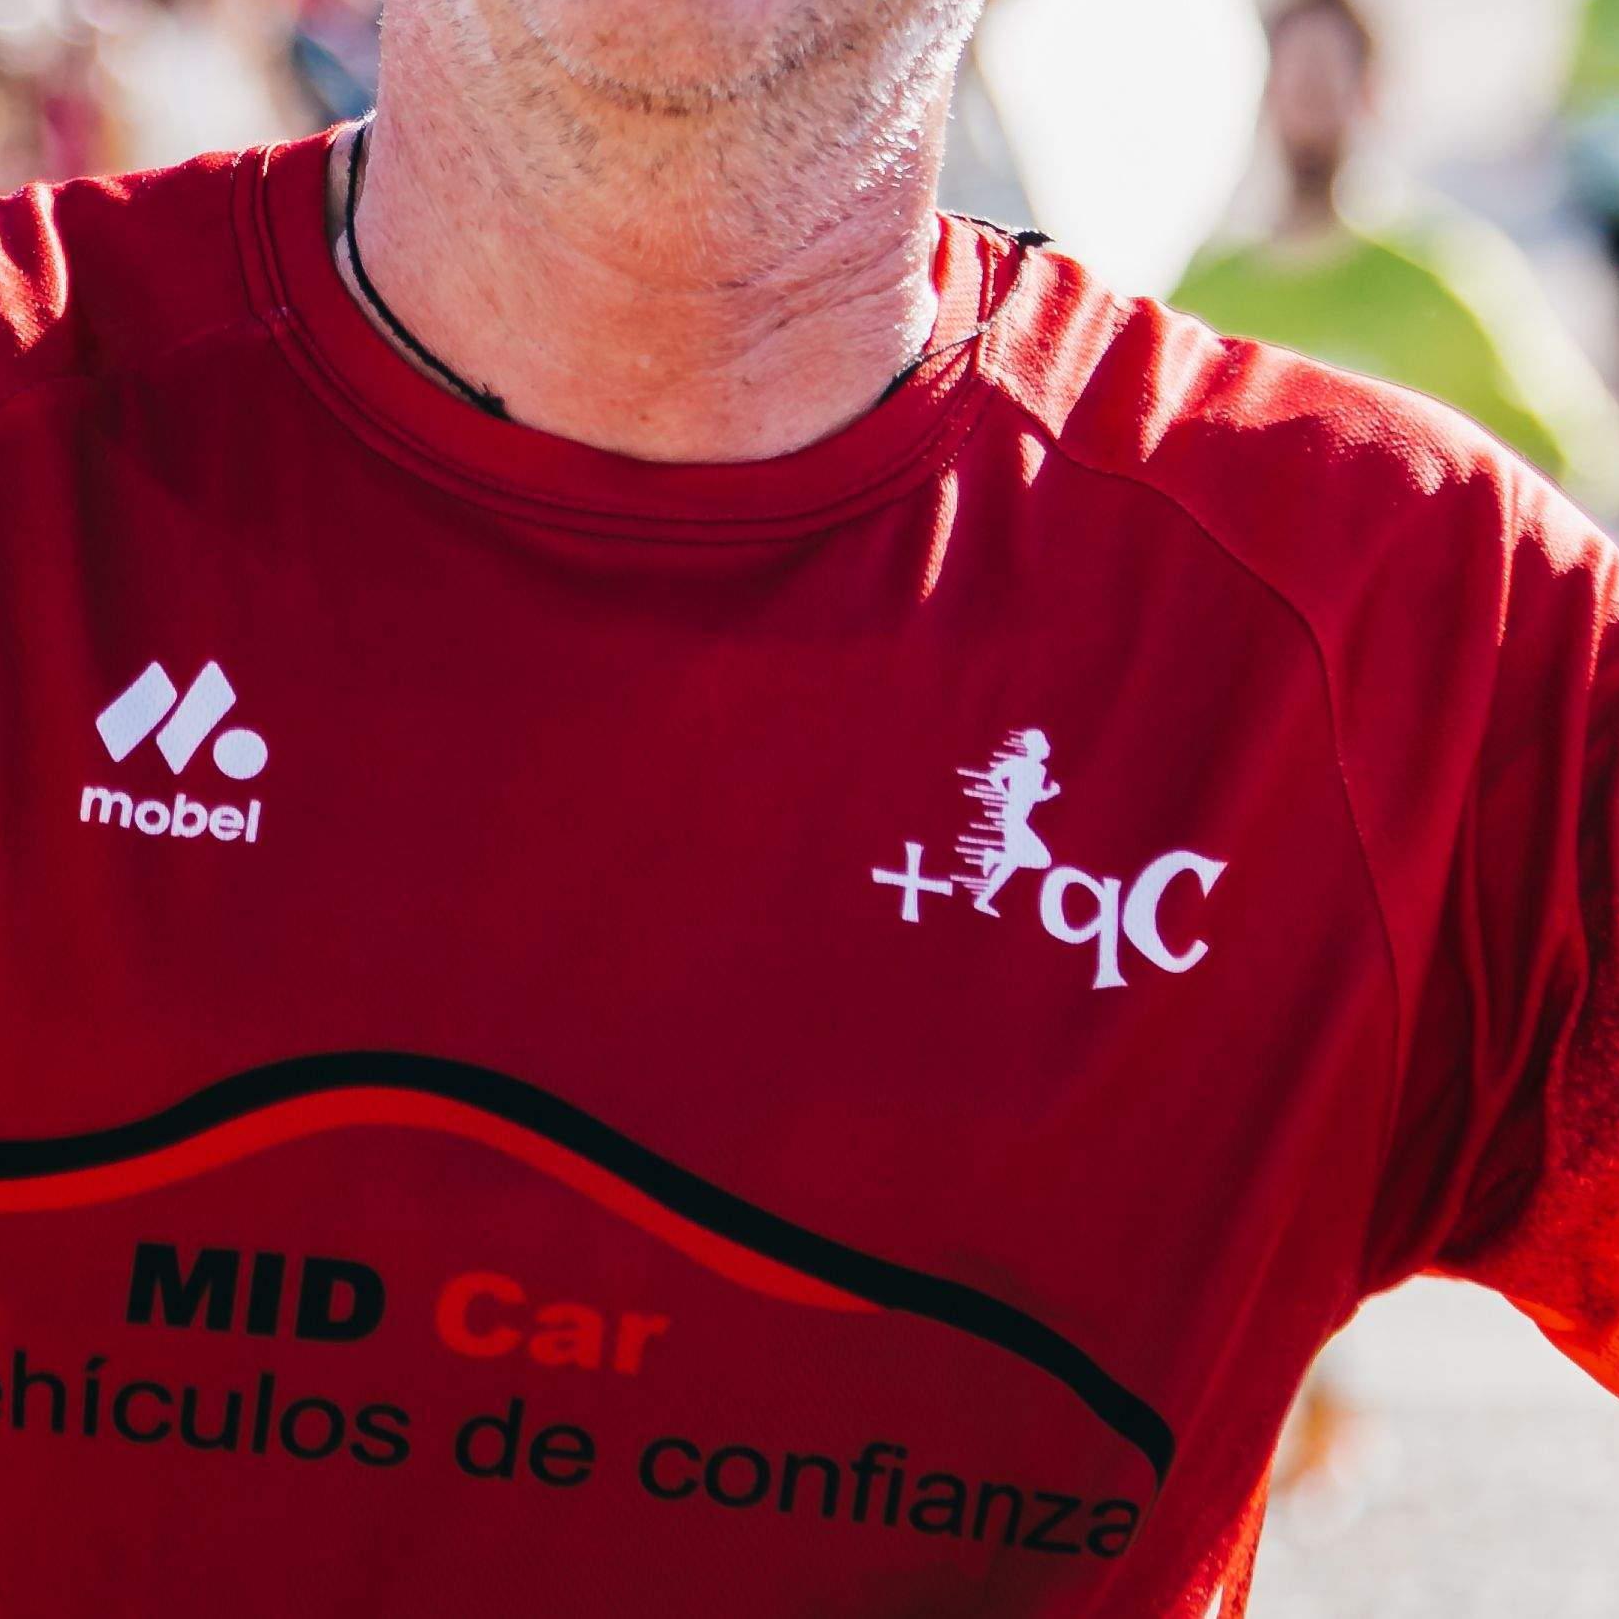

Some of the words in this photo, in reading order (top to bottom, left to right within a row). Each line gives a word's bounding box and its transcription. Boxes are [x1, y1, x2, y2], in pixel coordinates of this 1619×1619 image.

[79, 785, 263, 844] mobel
[125, 1240, 388, 1344] MID
[434, 1270, 672, 1378] Car
[452, 1395, 598, 1490] de
[636, 1434, 1141, 1561] confianza
